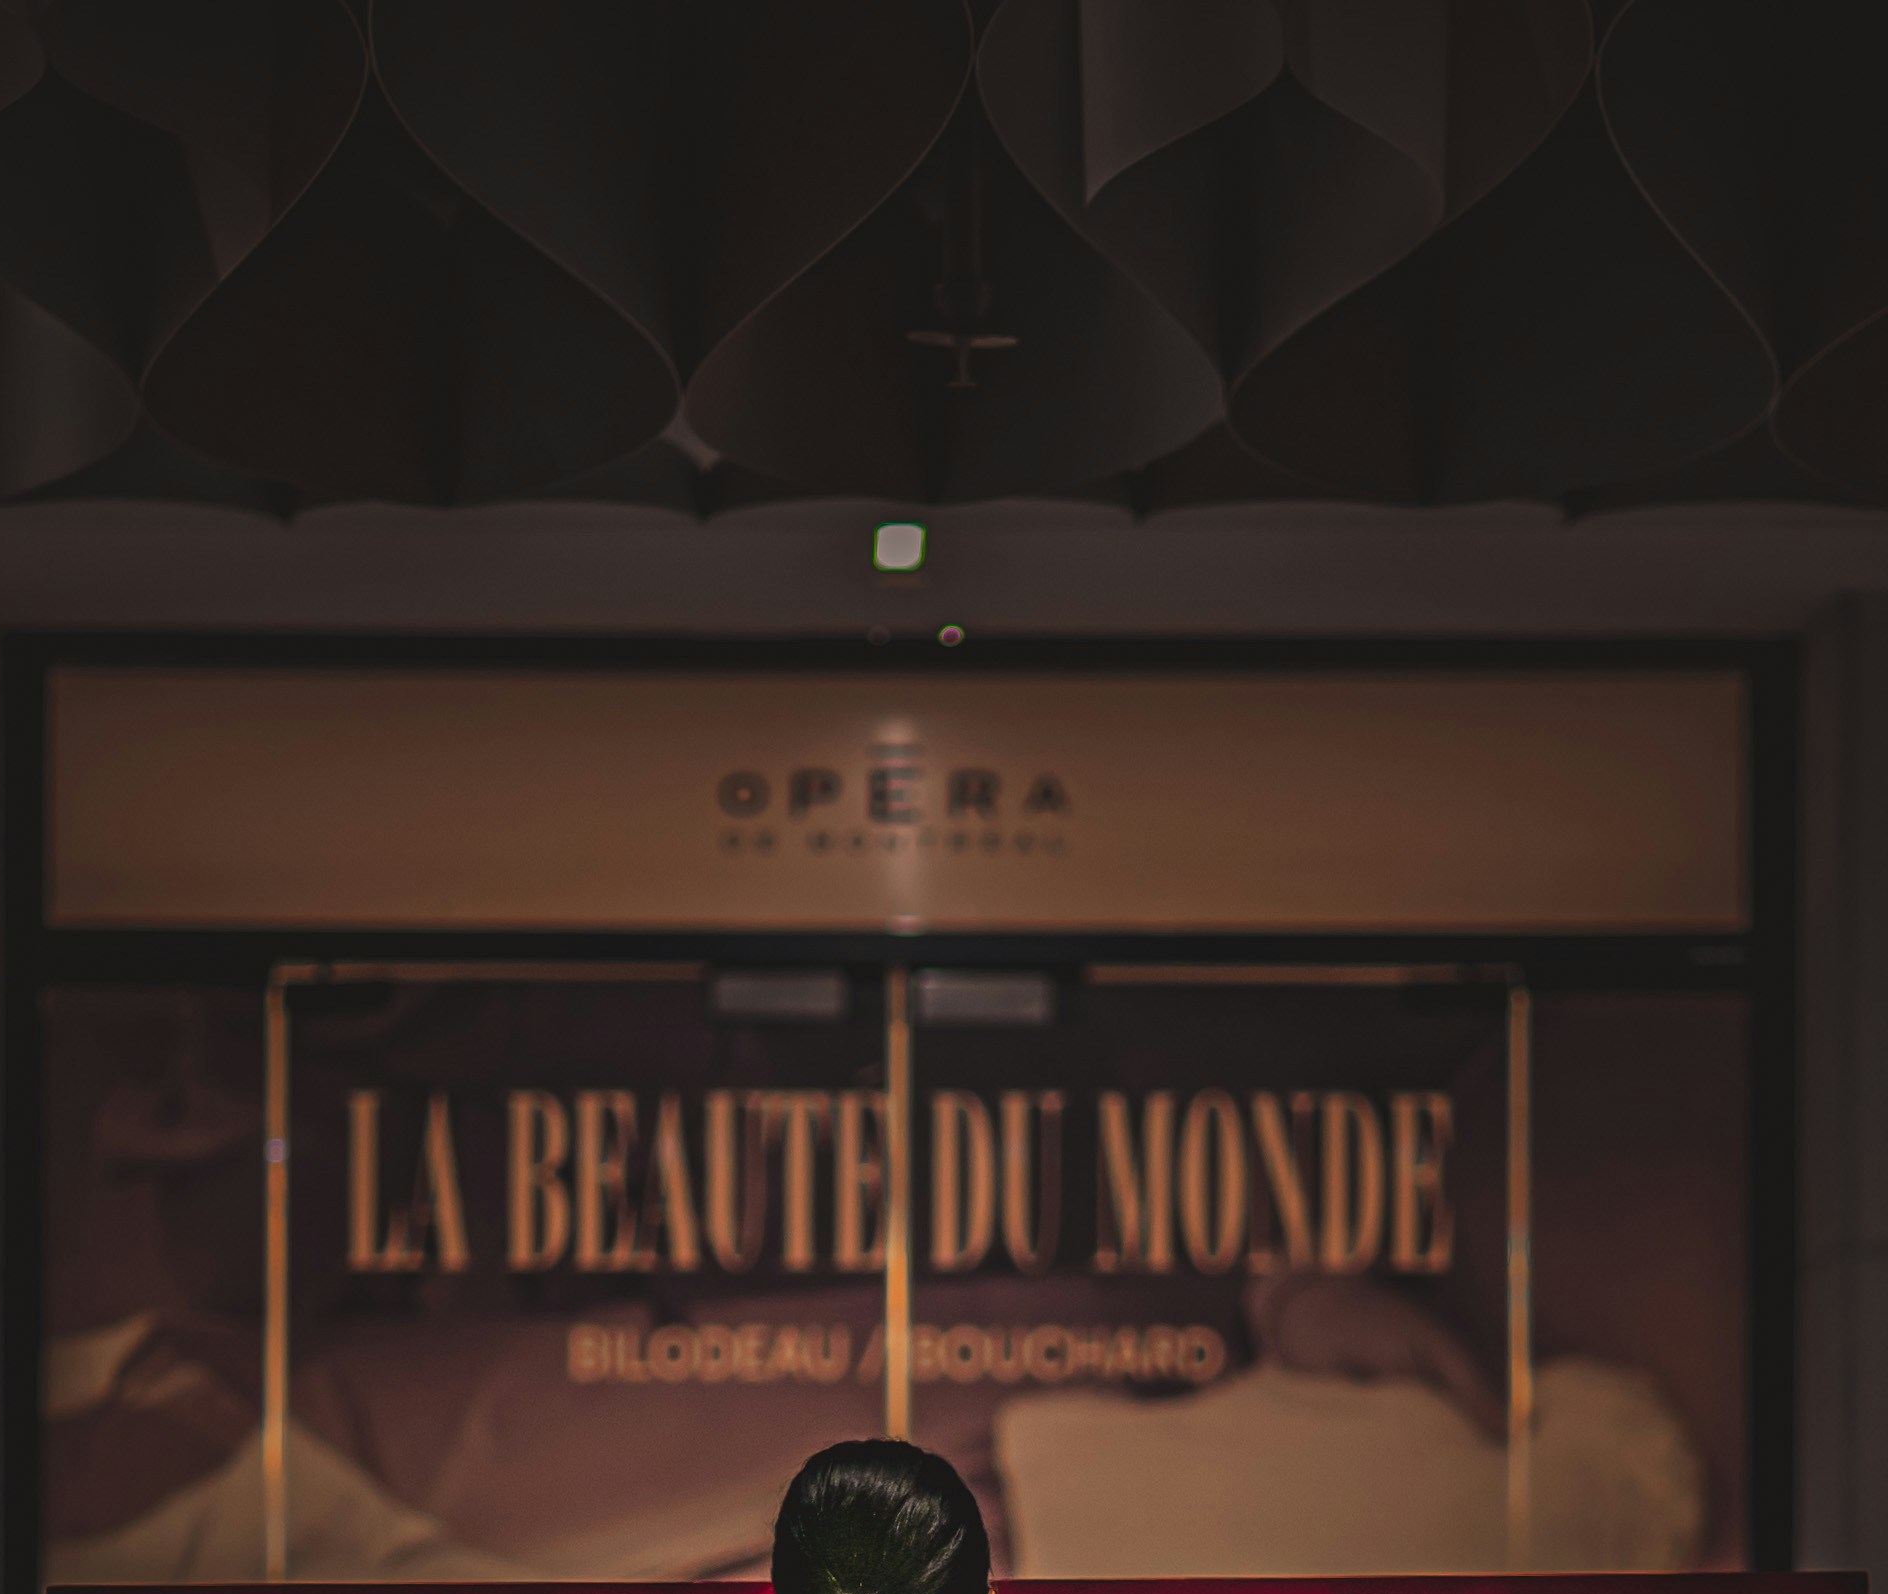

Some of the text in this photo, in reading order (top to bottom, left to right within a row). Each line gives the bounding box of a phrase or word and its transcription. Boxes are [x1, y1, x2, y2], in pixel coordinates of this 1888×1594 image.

[347, 1088, 469, 1274] LA
[928, 1088, 1066, 1276] DU
[1092, 1086, 1456, 1276] MONDE
[566, 1323, 852, 1384] BILODEAU
[902, 1322, 1226, 1384] BOUCHARD
